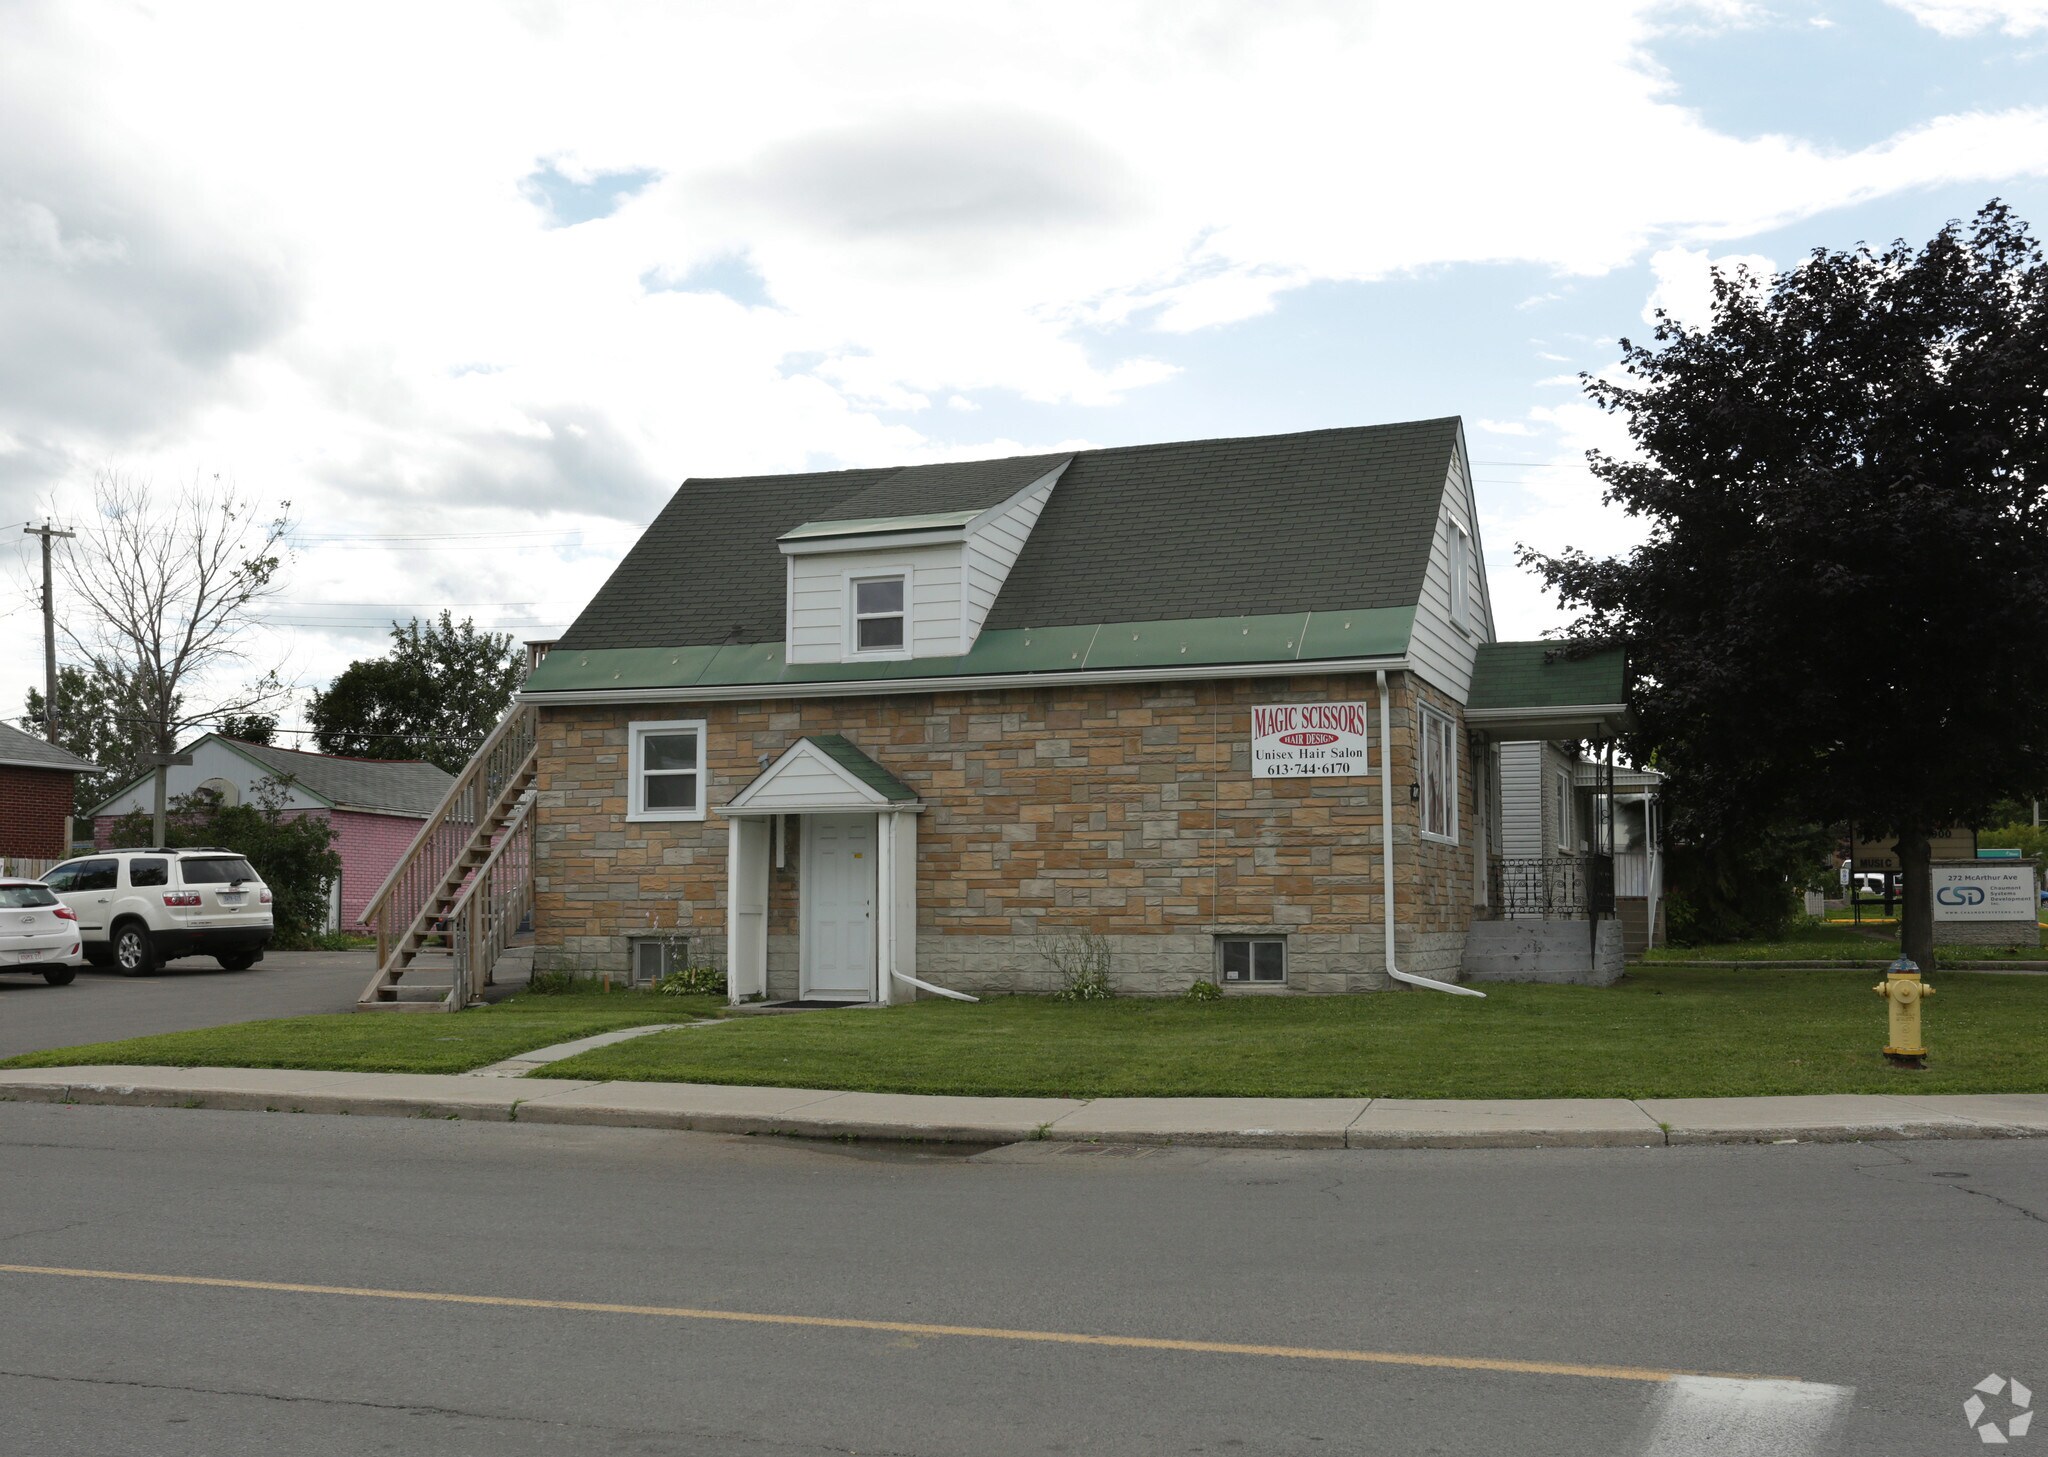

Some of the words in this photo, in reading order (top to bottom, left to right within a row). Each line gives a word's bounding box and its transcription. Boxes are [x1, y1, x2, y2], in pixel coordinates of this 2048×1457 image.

[1254, 707, 1297, 740] MAGIC
[1301, 704, 1365, 736] SCISSORS
[1284, 734, 1304, 745] HAIR
[1306, 733, 1334, 745] DESIGN
[1255, 749, 1294, 760] Unisex
[1299, 748, 1326, 759] Hair
[1330, 747, 1363, 758] Salon
[1859, 858, 1892, 868] MUSIC
